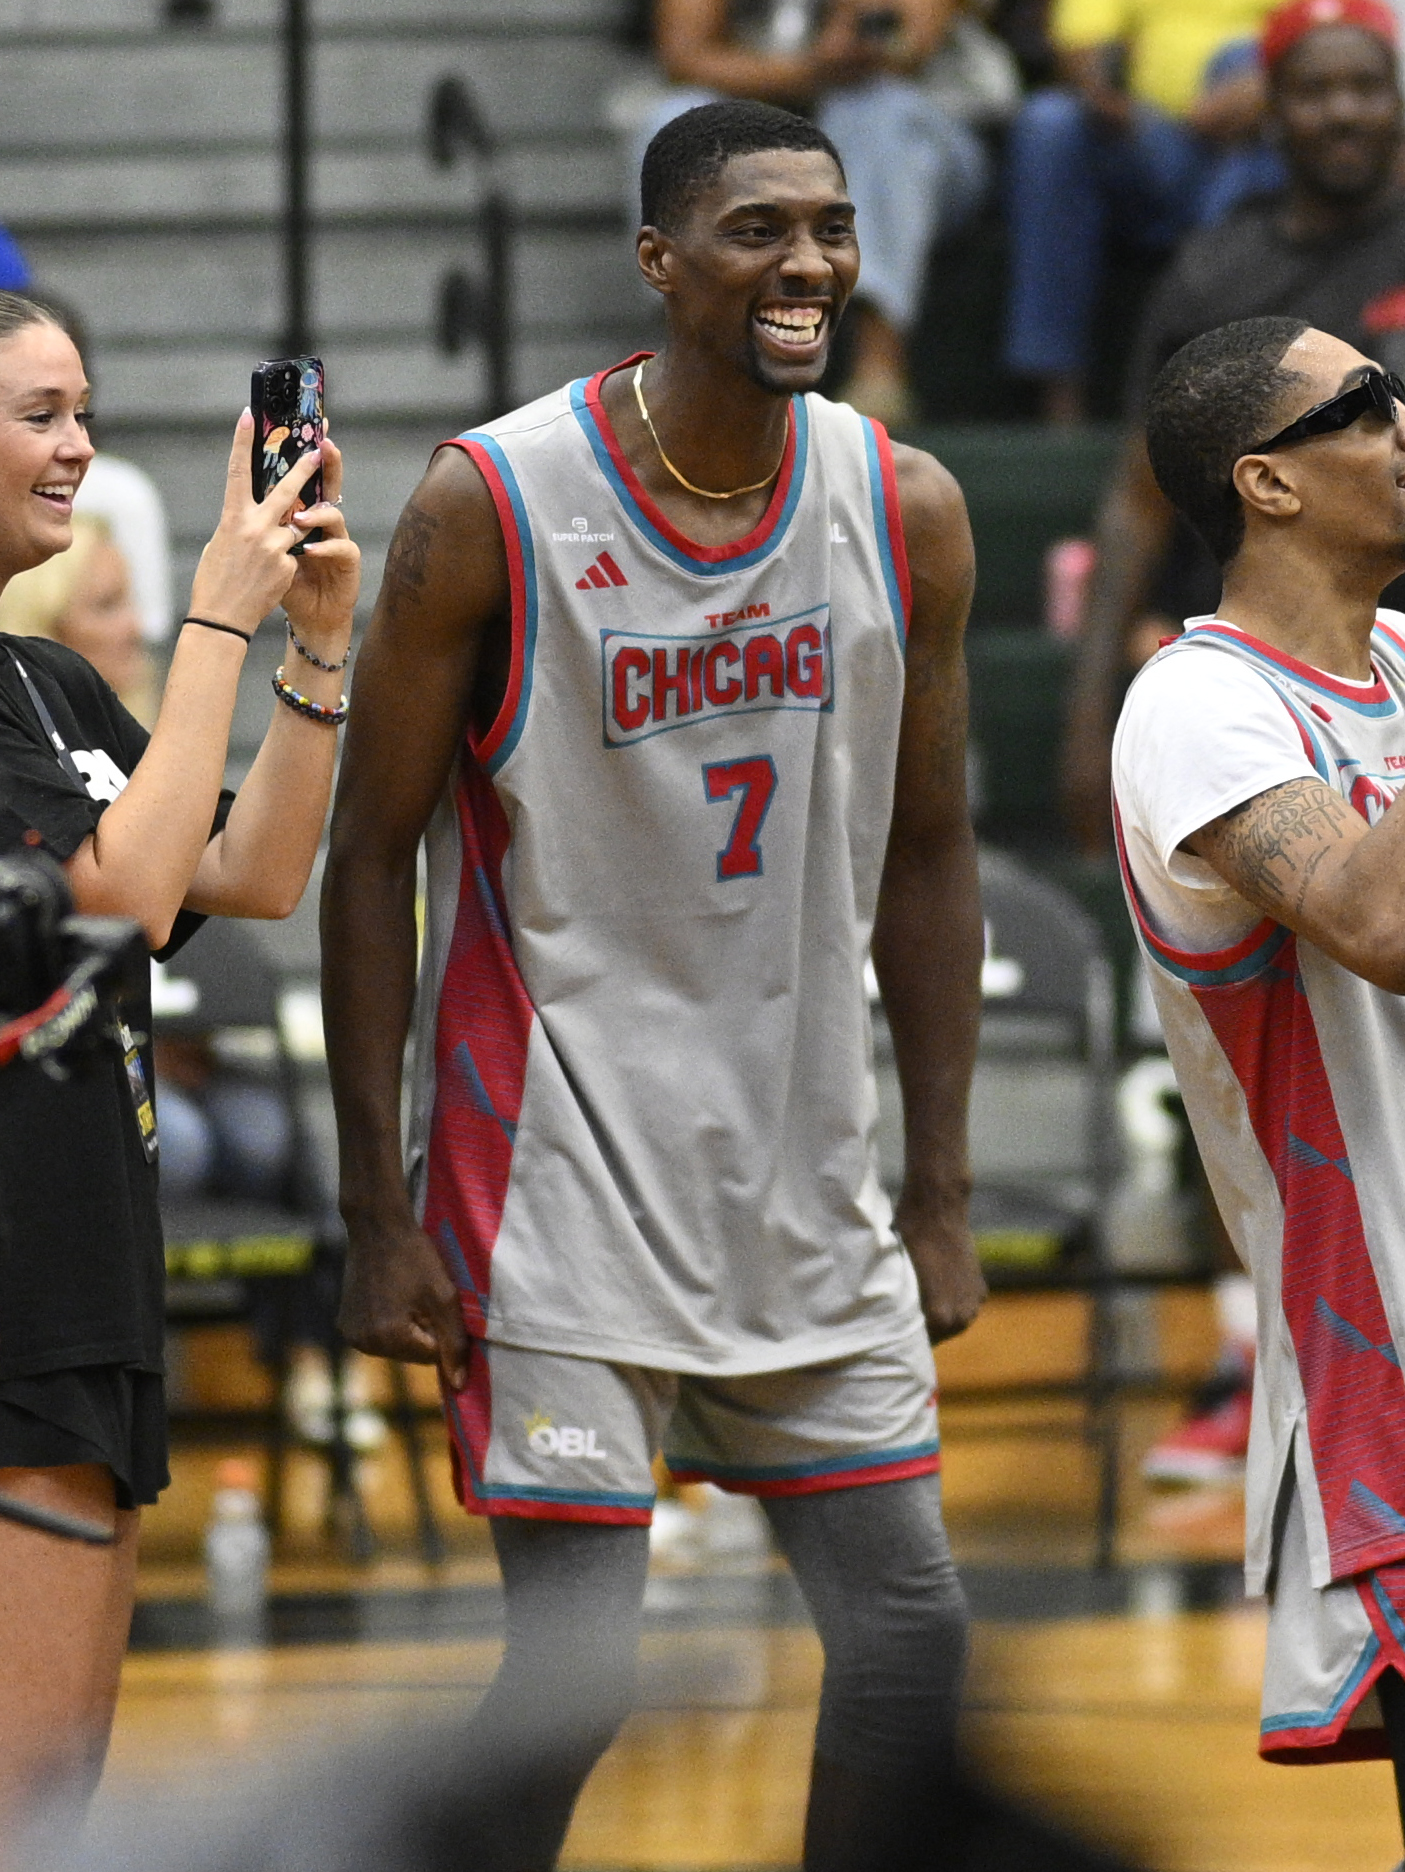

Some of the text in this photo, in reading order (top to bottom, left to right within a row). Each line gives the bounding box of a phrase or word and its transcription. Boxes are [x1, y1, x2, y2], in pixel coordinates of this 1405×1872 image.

[552, 532, 615, 542] SUPER PATCH
[704, 602, 771, 629] TEAM
[612, 623, 831, 732] CHICAG
[701, 753, 780, 883] 7
[527, 1425, 608, 1460] OBL
